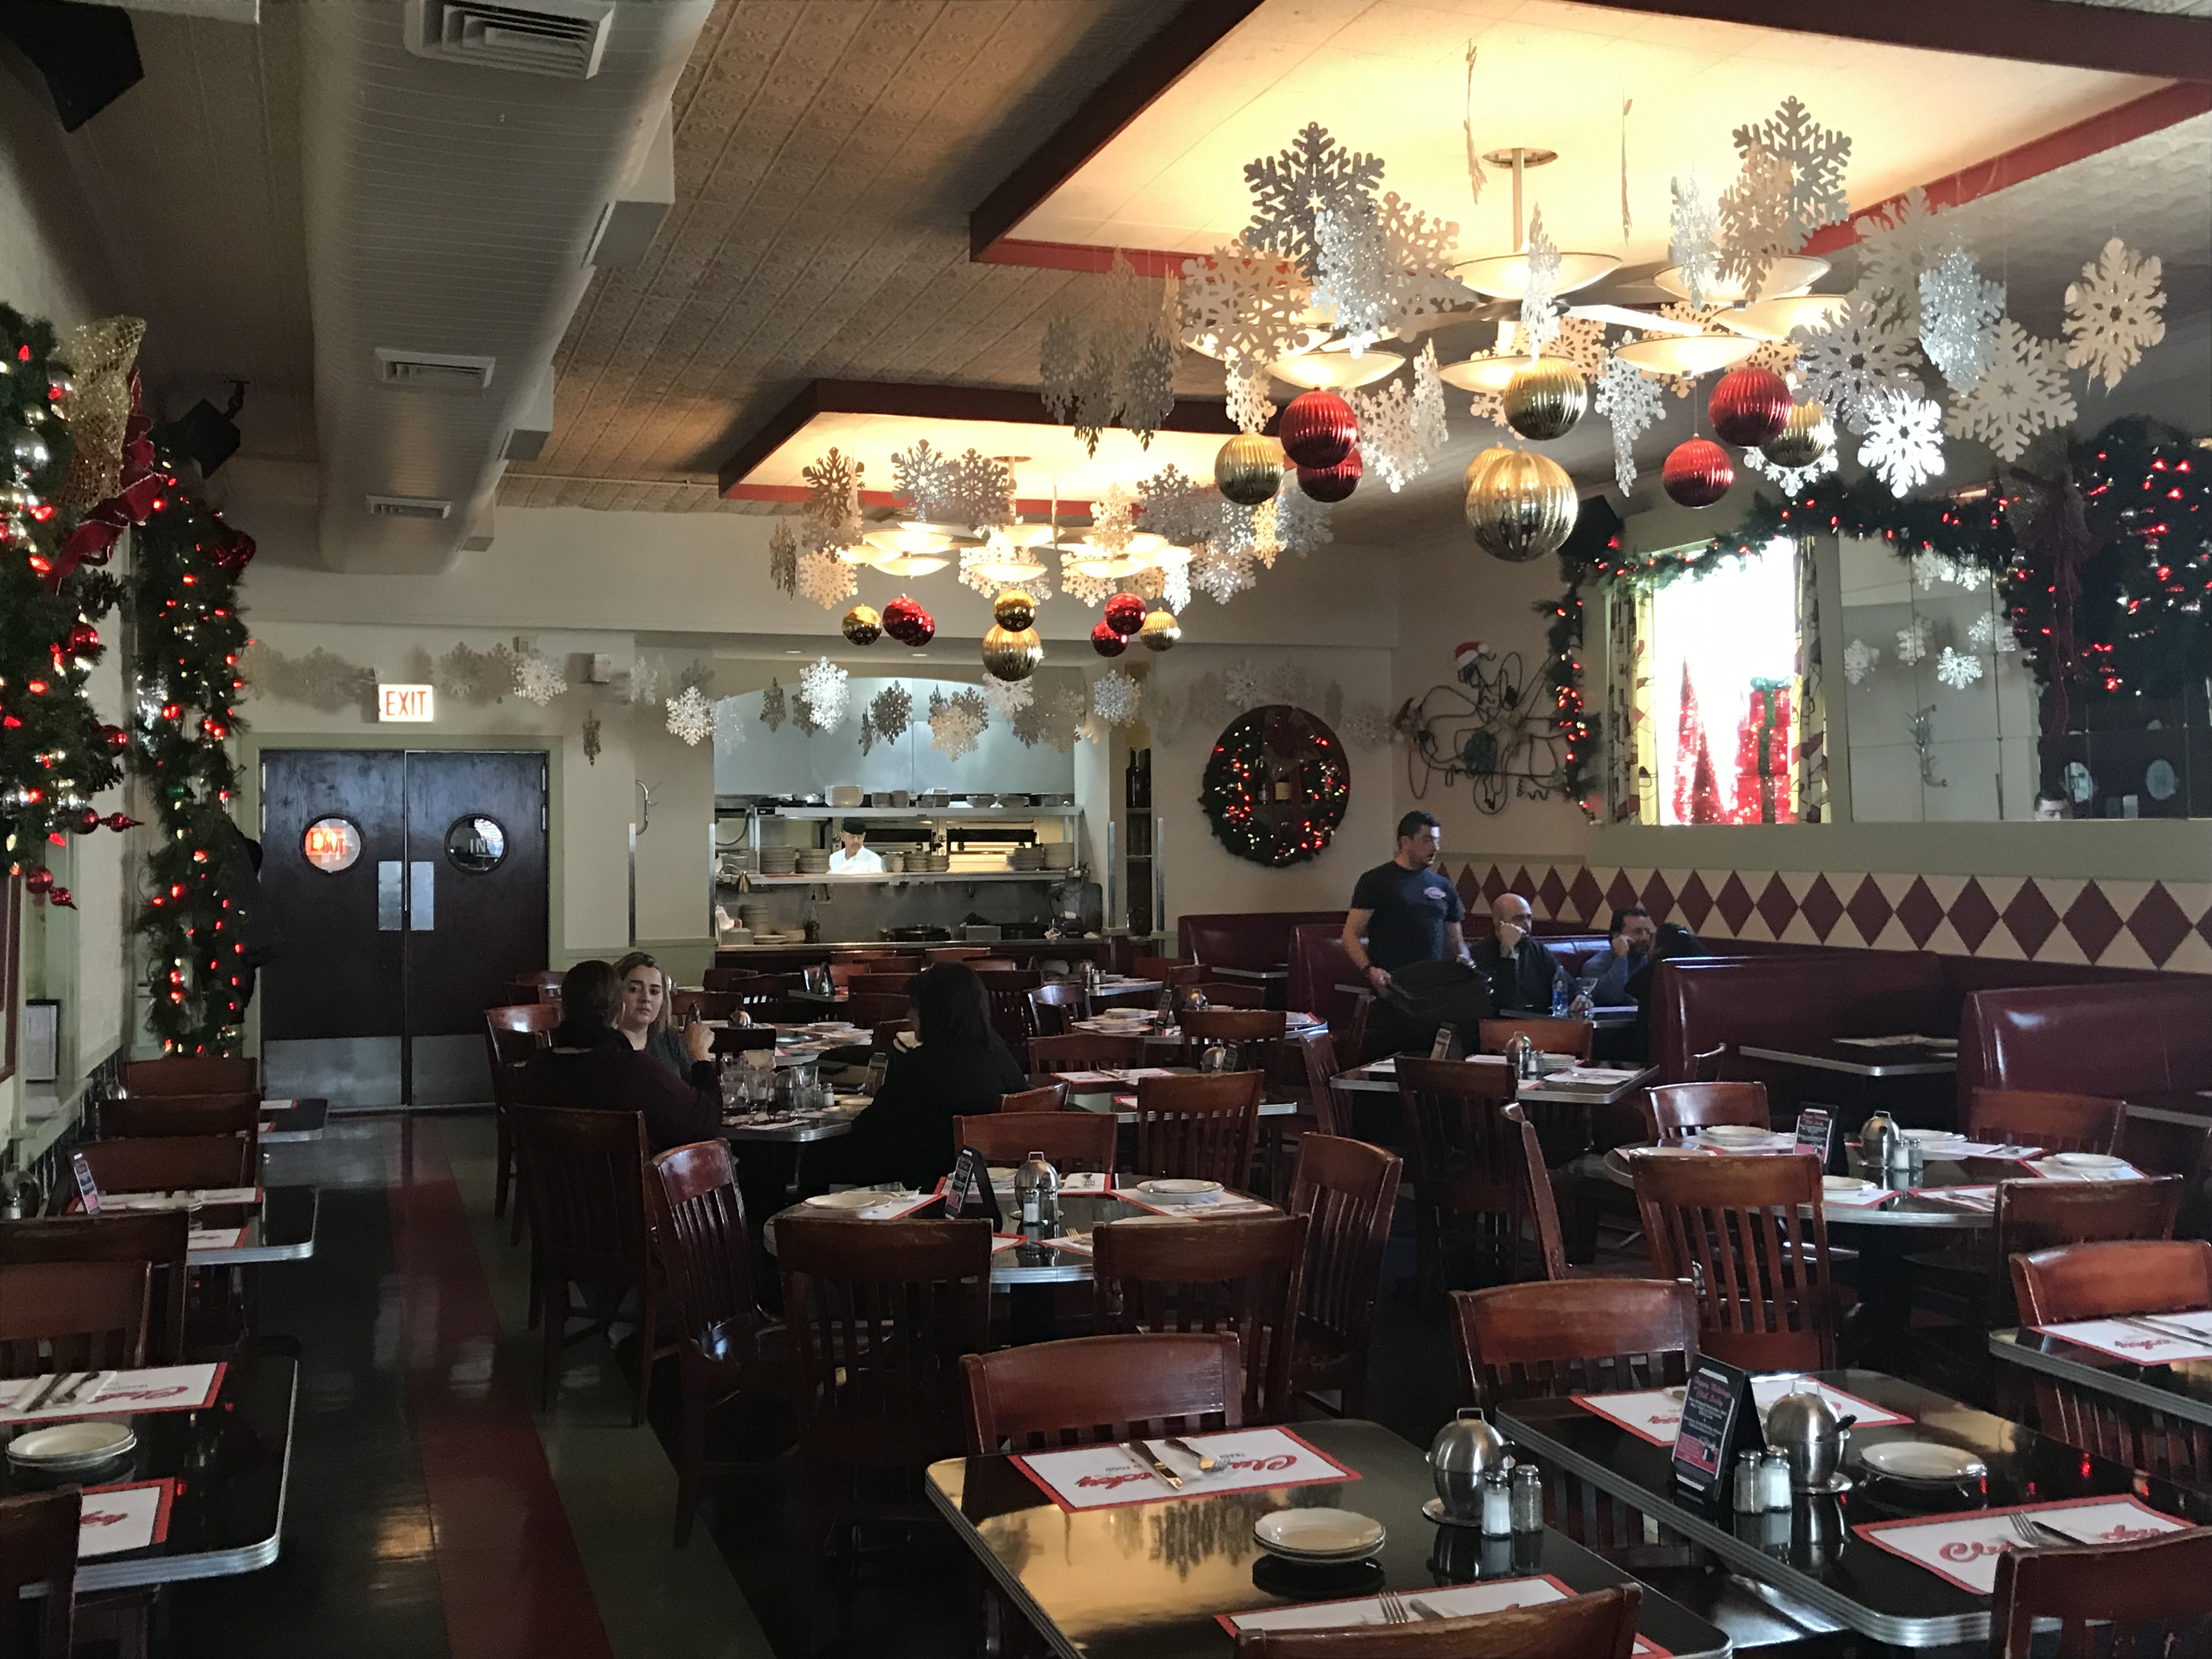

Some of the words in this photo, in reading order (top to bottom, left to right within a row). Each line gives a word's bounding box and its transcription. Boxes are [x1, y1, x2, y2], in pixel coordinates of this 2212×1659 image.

[386, 691, 427, 716] EXIT
[470, 837, 486, 854] IN
[1228, 1454, 1297, 1471] Clu
[1939, 1540, 2016, 1563] Clu
